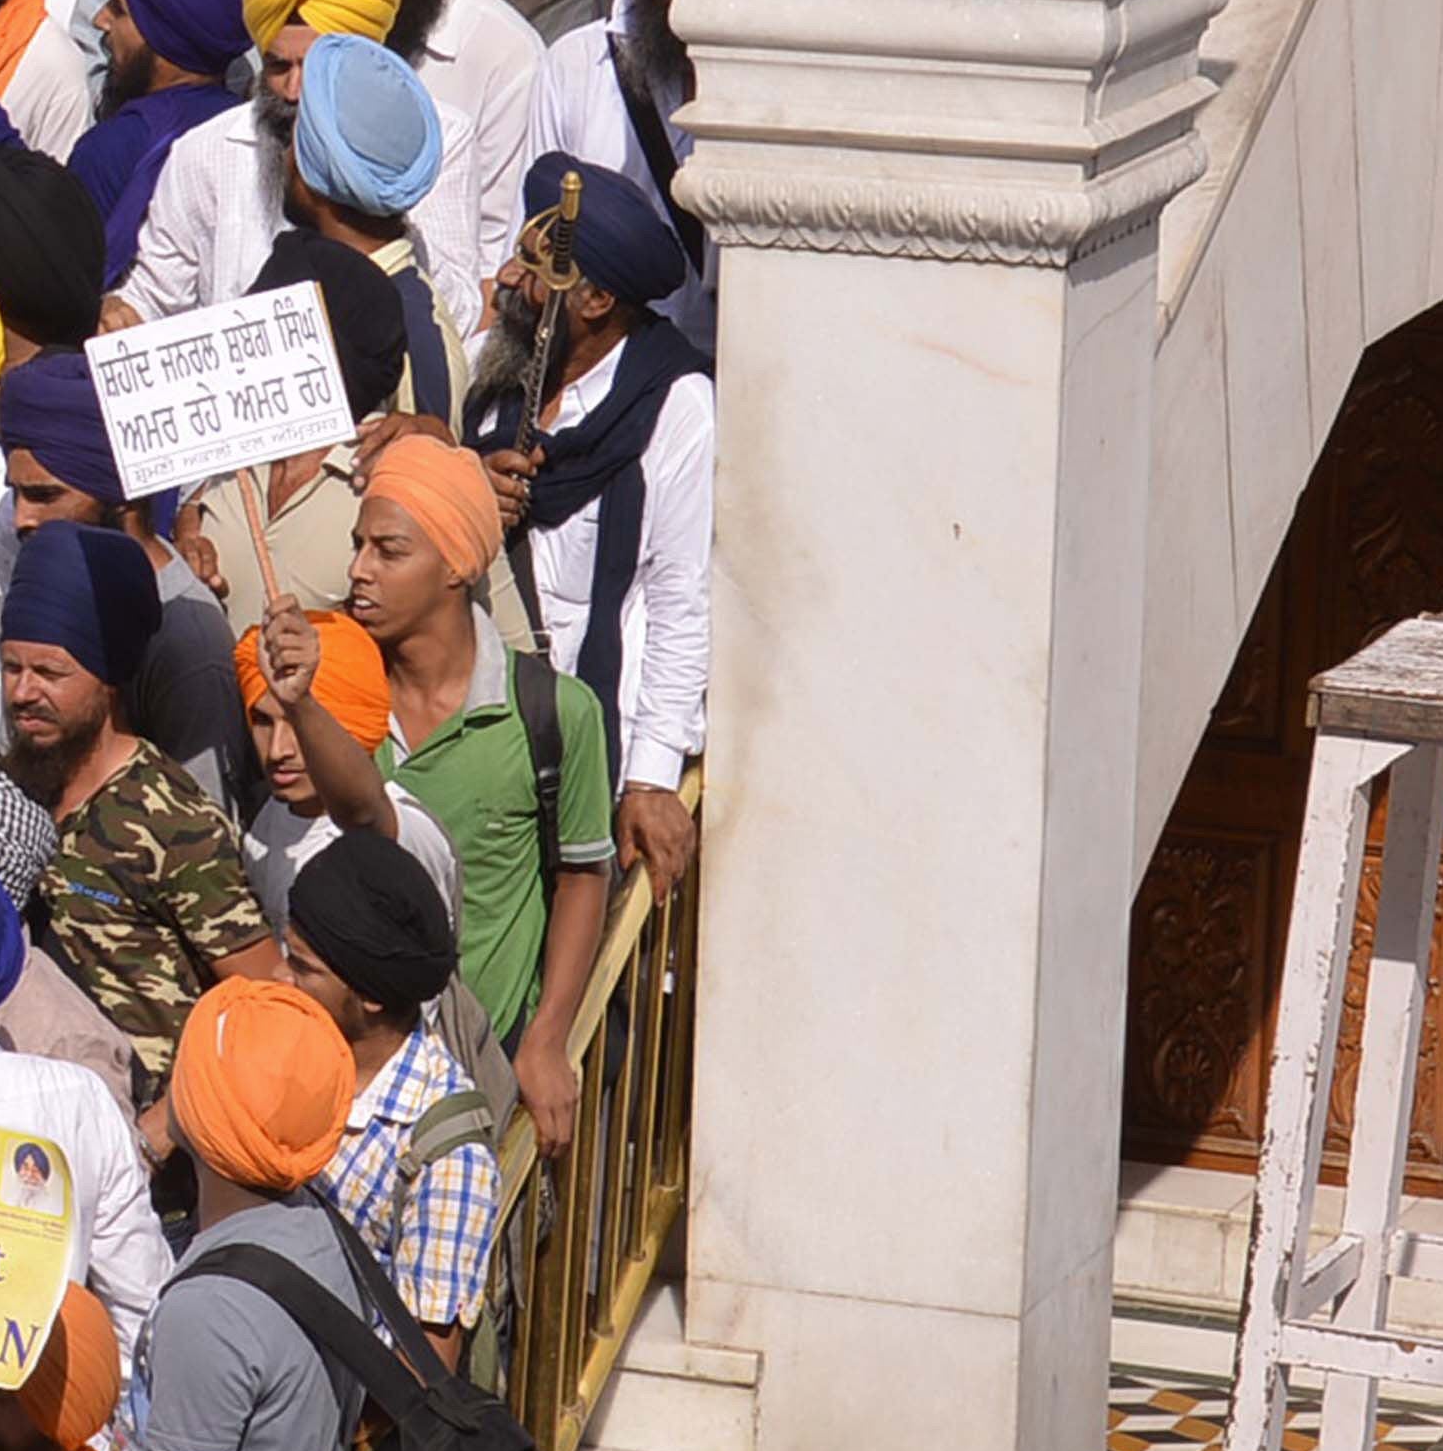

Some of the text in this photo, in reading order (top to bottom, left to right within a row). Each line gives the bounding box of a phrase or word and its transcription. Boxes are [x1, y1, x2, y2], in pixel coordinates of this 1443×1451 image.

[98, 341, 154, 397] ਸ਼ਹੀਦ
[156, 333, 219, 385] ਜਨਰਲ
[273, 296, 320, 351] ਸਿੰਘ
[117, 354, 332, 453] ਅਮਰ ਰਹੇ ਅਮਰ ਰਹੇ
